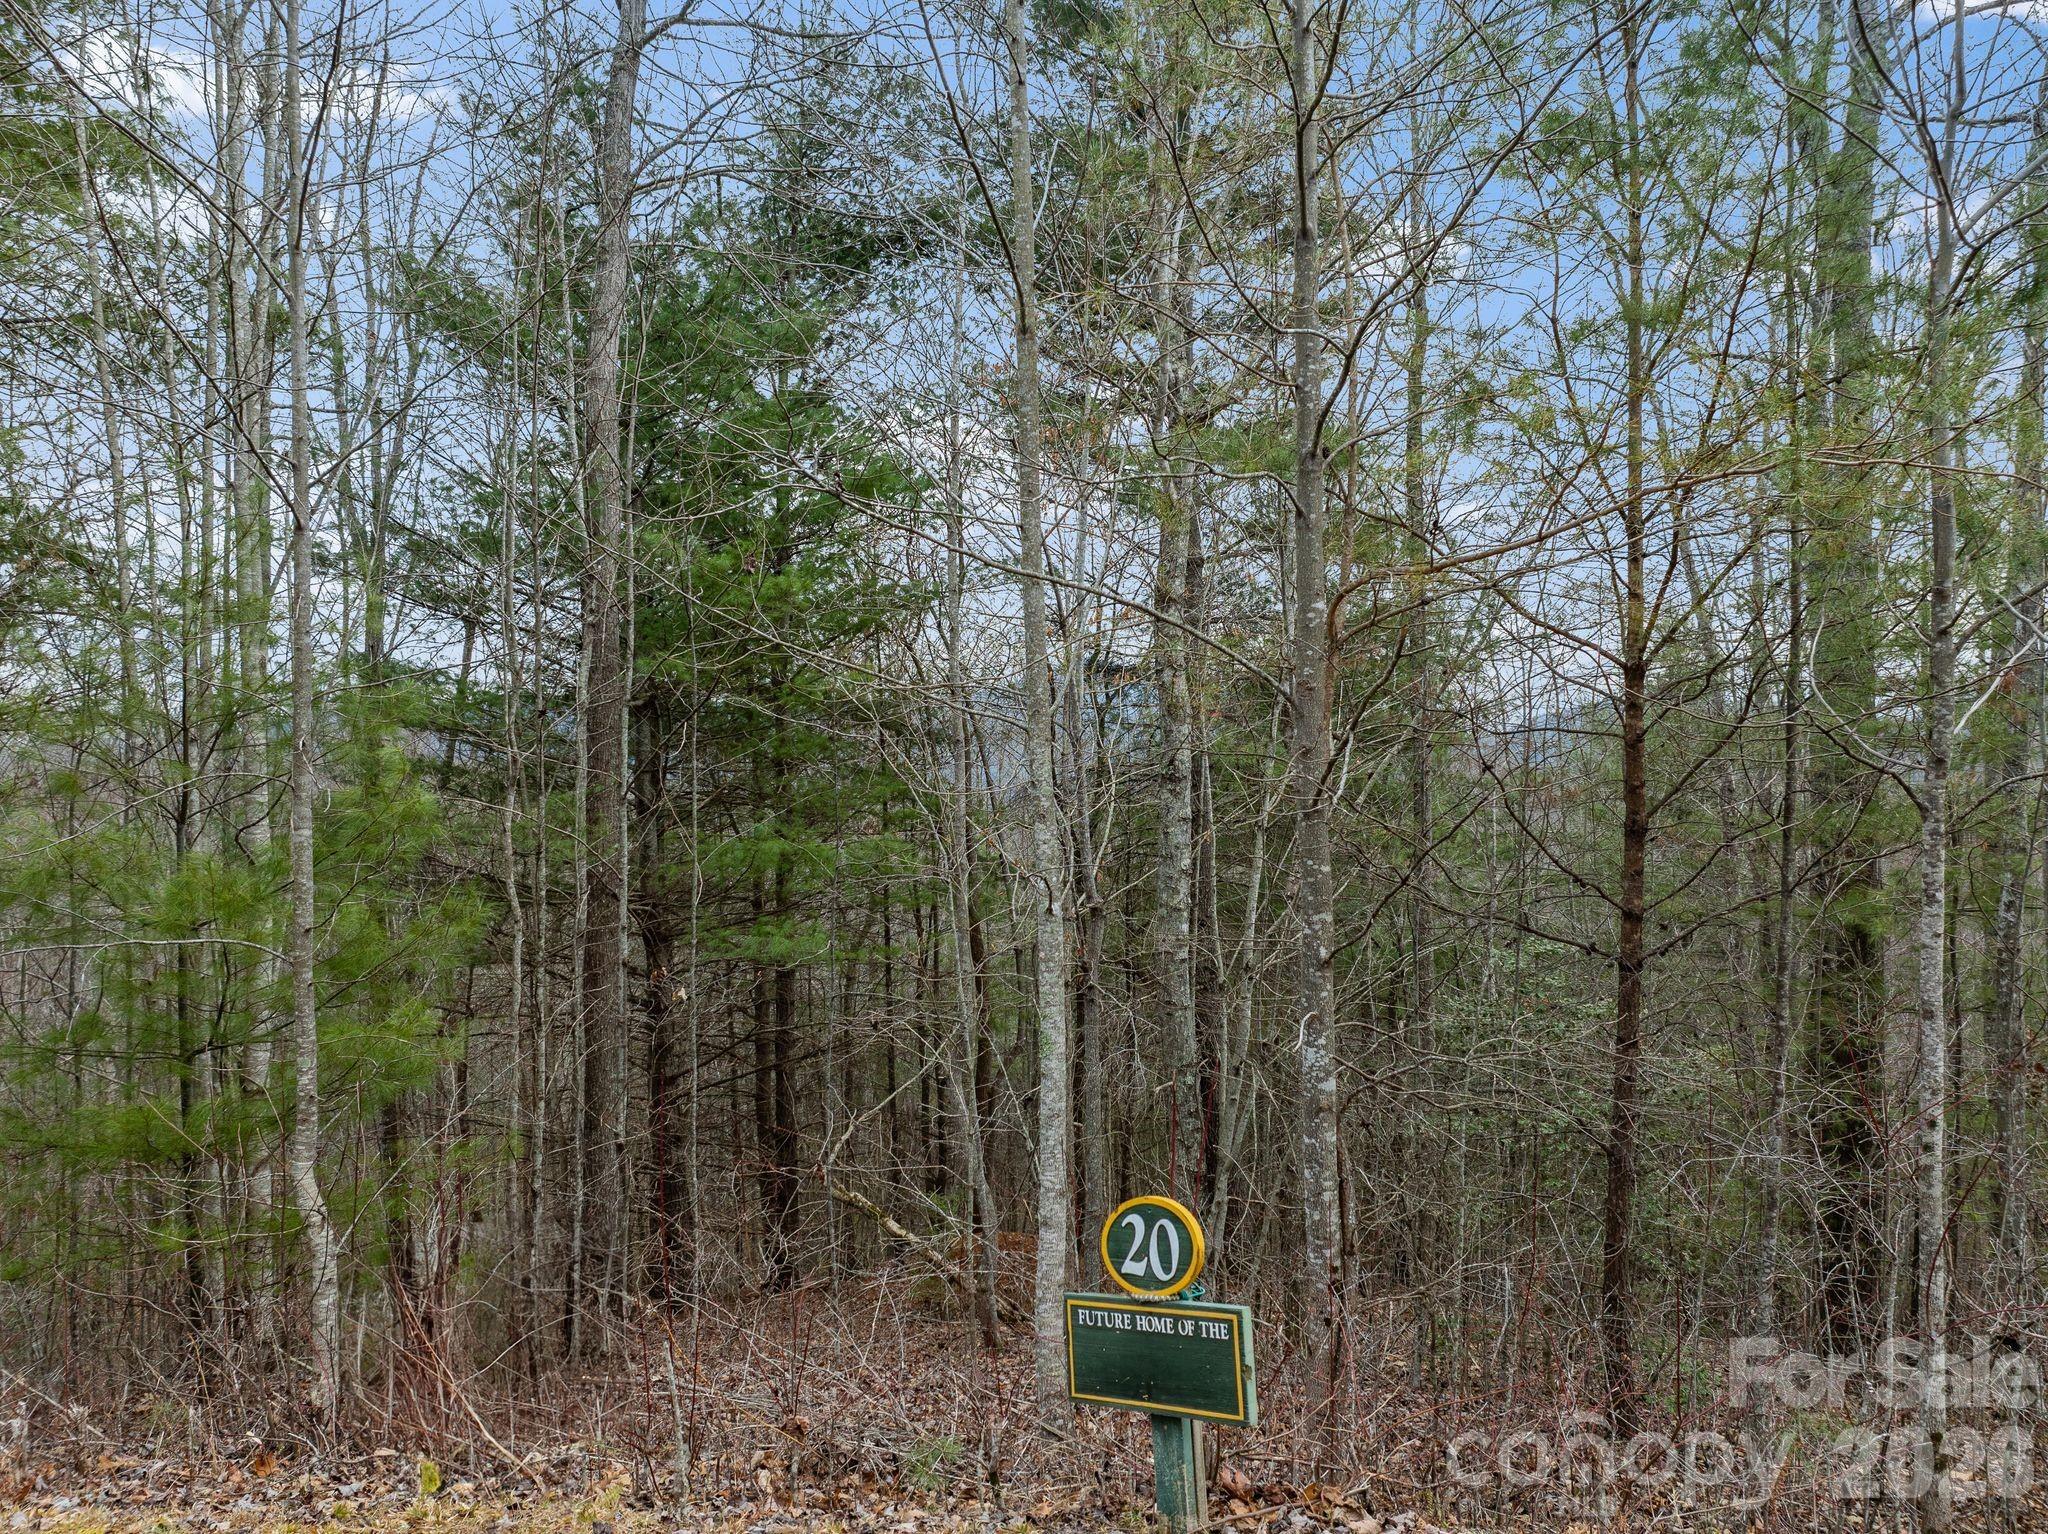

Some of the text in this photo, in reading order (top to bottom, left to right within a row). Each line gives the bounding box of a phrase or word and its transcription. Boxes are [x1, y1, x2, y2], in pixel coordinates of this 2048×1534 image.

[1121, 1213, 1179, 1281] 20
[1078, 1309, 1230, 1340] FUTURE HOME OF THE
